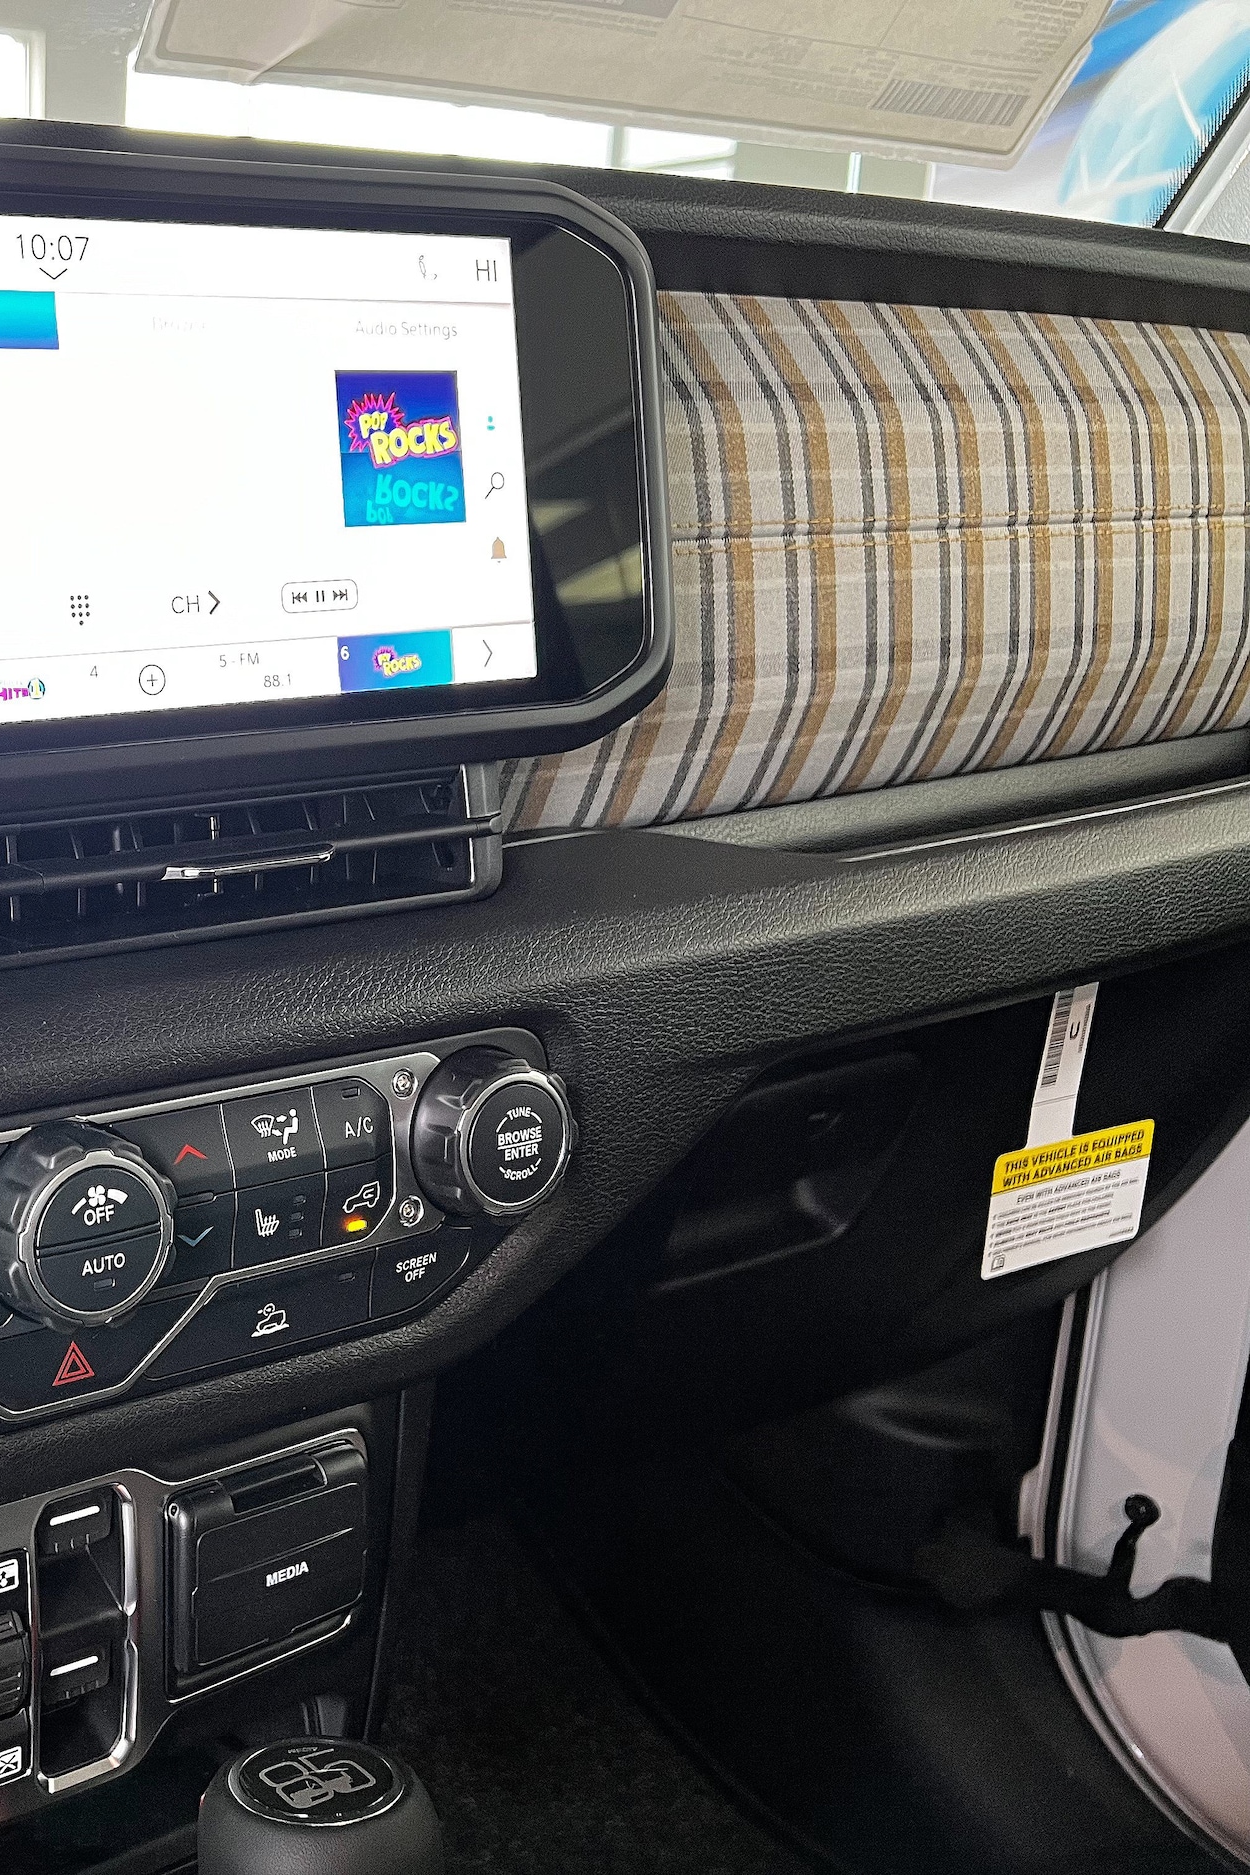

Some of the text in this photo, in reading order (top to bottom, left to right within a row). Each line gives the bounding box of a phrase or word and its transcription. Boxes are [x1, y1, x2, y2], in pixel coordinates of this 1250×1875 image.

[16, 233, 90, 262] 10:07
[476, 259, 498, 282] HI
[355, 320, 459, 341] Audio Settings
[358, 411, 389, 439] POP
[369, 420, 457, 465] ROCKS
[170, 595, 202, 615] CH
[219, 654, 227, 668] 5
[239, 652, 260, 666] FM
[340, 645, 350, 661] 6
[89, 665, 99, 678] 4
[263, 673, 292, 688] 88.1
[506, 1106, 532, 1121] TUNE
[344, 1116, 374, 1139] A/C
[497, 1125, 542, 1147] BROWSE
[267, 1146, 298, 1163] MODE
[504, 1143, 539, 1161] ENTER
[1004, 1157, 1029, 1174] THIS
[1031, 1147, 1078, 1167] VEHICLE
[1091, 1129, 1145, 1152] EQUIPPED
[503, 1164, 539, 1181] SCROLL
[1002, 1142, 1143, 1188] WITH ADVANCED AIR BAGS
[83, 1203, 115, 1227] OFF
[81, 1252, 126, 1277] AUTO
[395, 1252, 437, 1274] SCREEN
[404, 1267, 426, 1283] OFF
[265, 1561, 310, 1587] MEDIA
